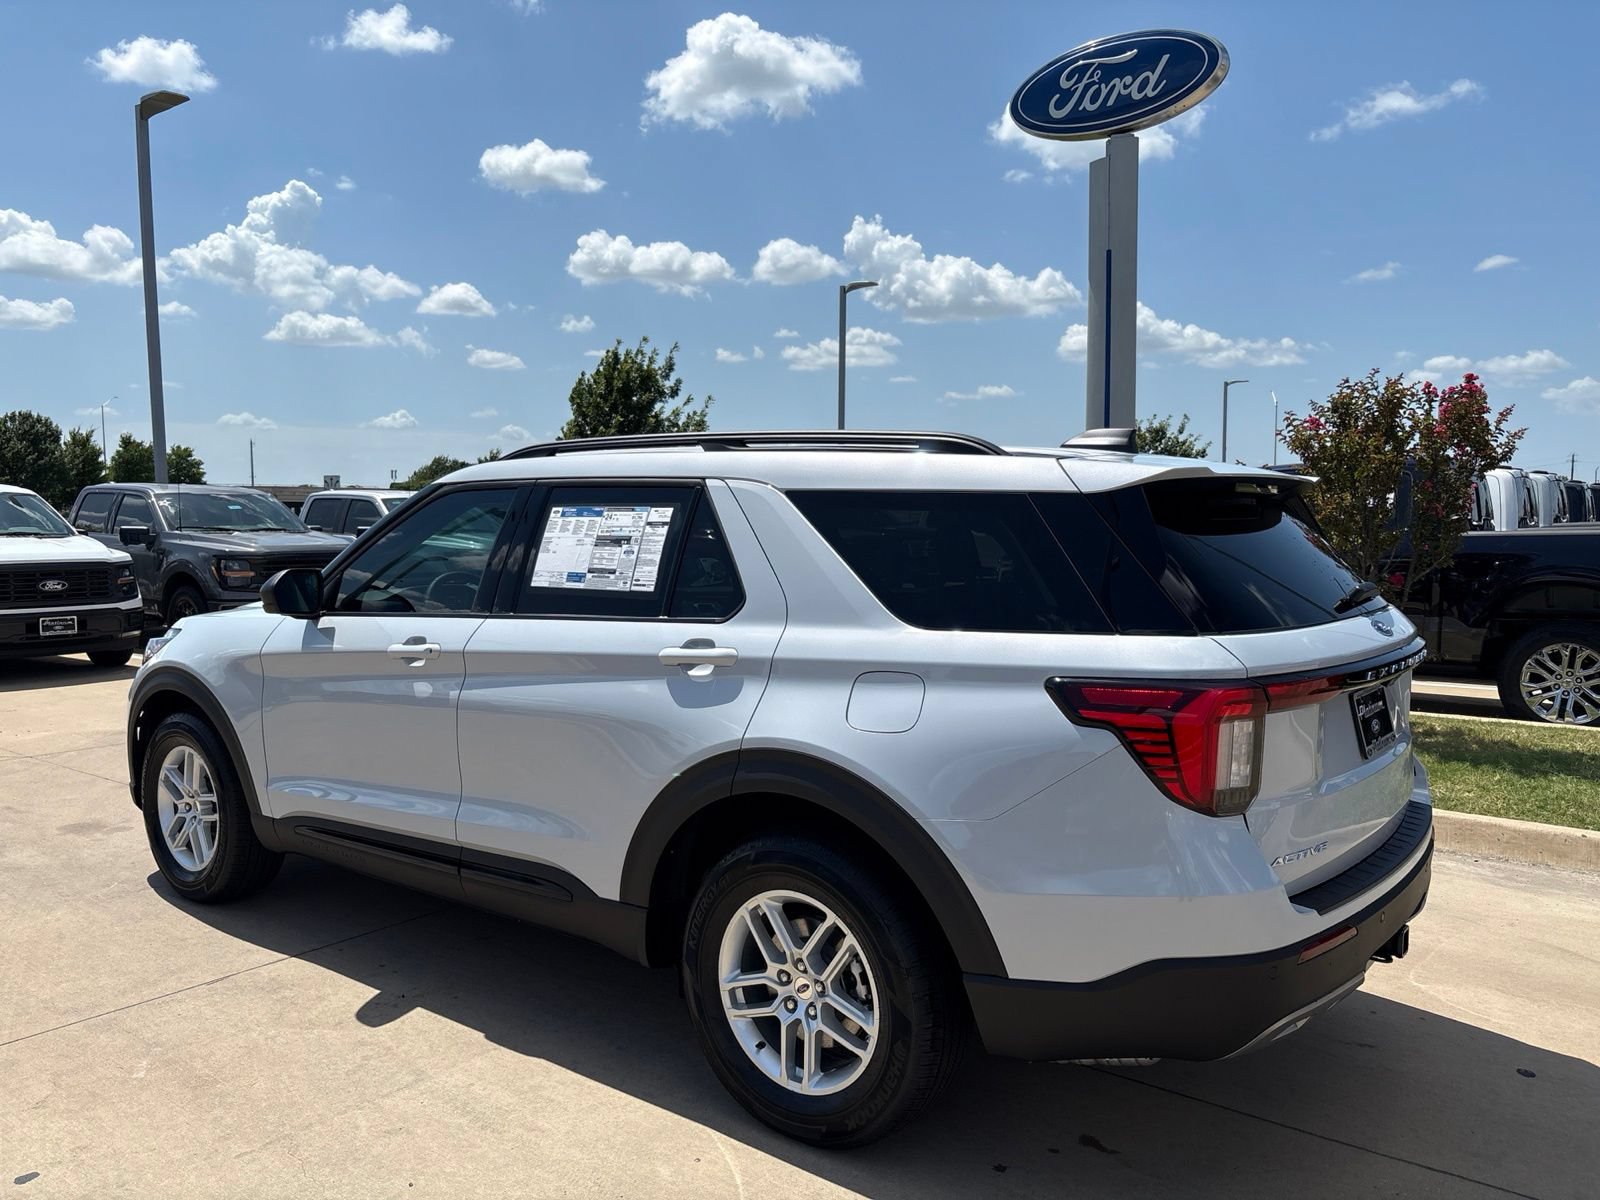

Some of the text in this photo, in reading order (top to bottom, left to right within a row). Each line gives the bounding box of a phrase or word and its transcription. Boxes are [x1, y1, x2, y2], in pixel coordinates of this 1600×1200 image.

[1048, 48, 1170, 119] Ford
[44, 581, 63, 590] Ford
[1270, 840, 1329, 868] ACTIVE
